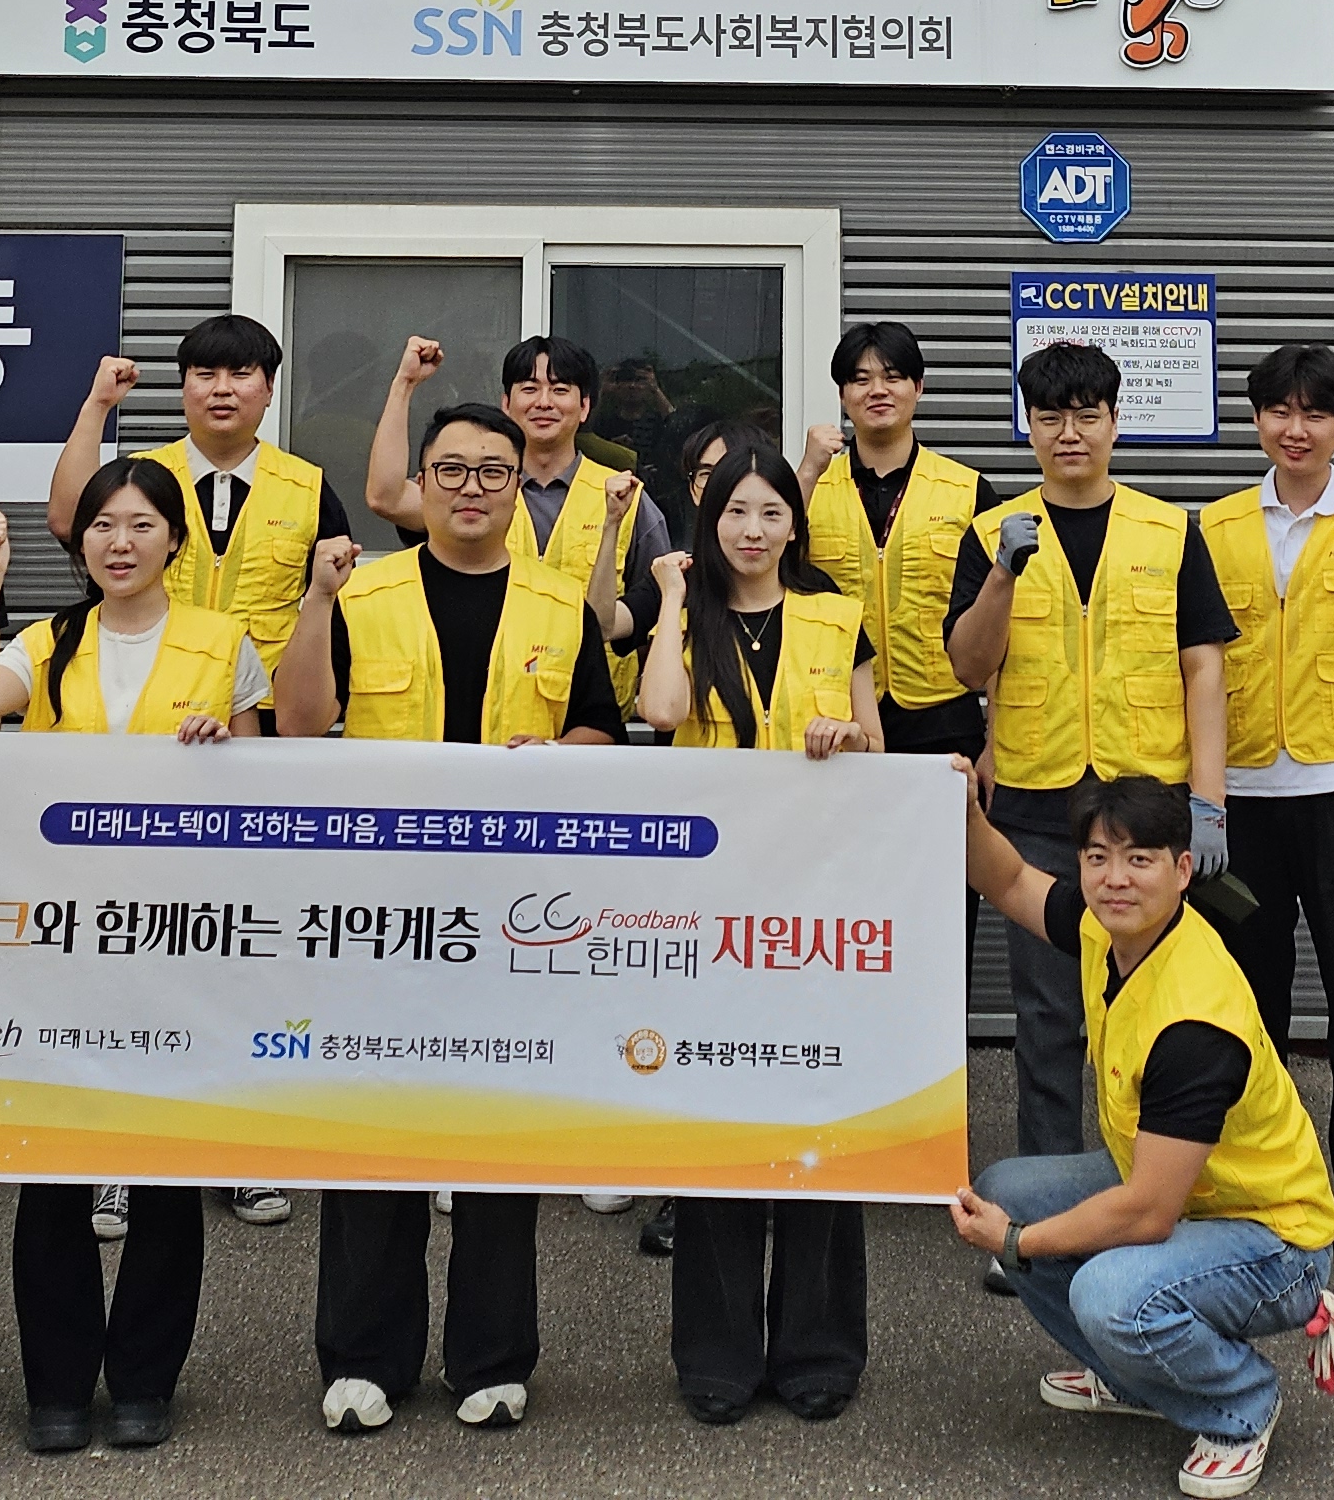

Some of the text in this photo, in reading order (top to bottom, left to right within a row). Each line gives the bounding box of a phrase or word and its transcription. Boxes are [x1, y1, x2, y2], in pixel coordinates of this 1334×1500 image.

[411, 7, 523, 58] SSN
[536, 12, 955, 60] 충청북도사회복지협의회
[1039, 165, 1114, 205] ADT
[1045, 282, 1209, 313] CCTV설치안내
[1026, 325, 1045, 336] 범죄
[1071, 325, 1089, 336] 시설
[1091, 325, 1110, 336] 안전
[1112, 325, 1140, 336] 관리를
[1142, 325, 1161, 336] 위해
[1162, 326, 1202, 337] CCTV가
[1108, 338, 1118, 348] 및
[1120, 338, 1157, 348] 녹화되고
[1159, 338, 1197, 349] 있습니다
[1144, 360, 1162, 370] 시설
[1163, 360, 1181, 370] 안전
[1182, 360, 1200, 370] 관리
[1126, 395, 1143, 405] 주요
[1145, 395, 1162, 405] 시설
[71, 809, 692, 852] 미래나노텍이 전하는 마음, 든든한 한 끼, 꿈꾸는 미래
[597, 907, 701, 931] Foodbank
[95, 900, 283, 958] 함께하는
[297, 903, 481, 963] 취약계층
[713, 914, 894, 973] 지원사업
[38, 1028, 193, 1053] 미래나노텍(주)
[251, 1031, 555, 1064] SSN 충청북도사회복지협의회
[673, 1039, 843, 1070] 충북광역푸드뱅크
